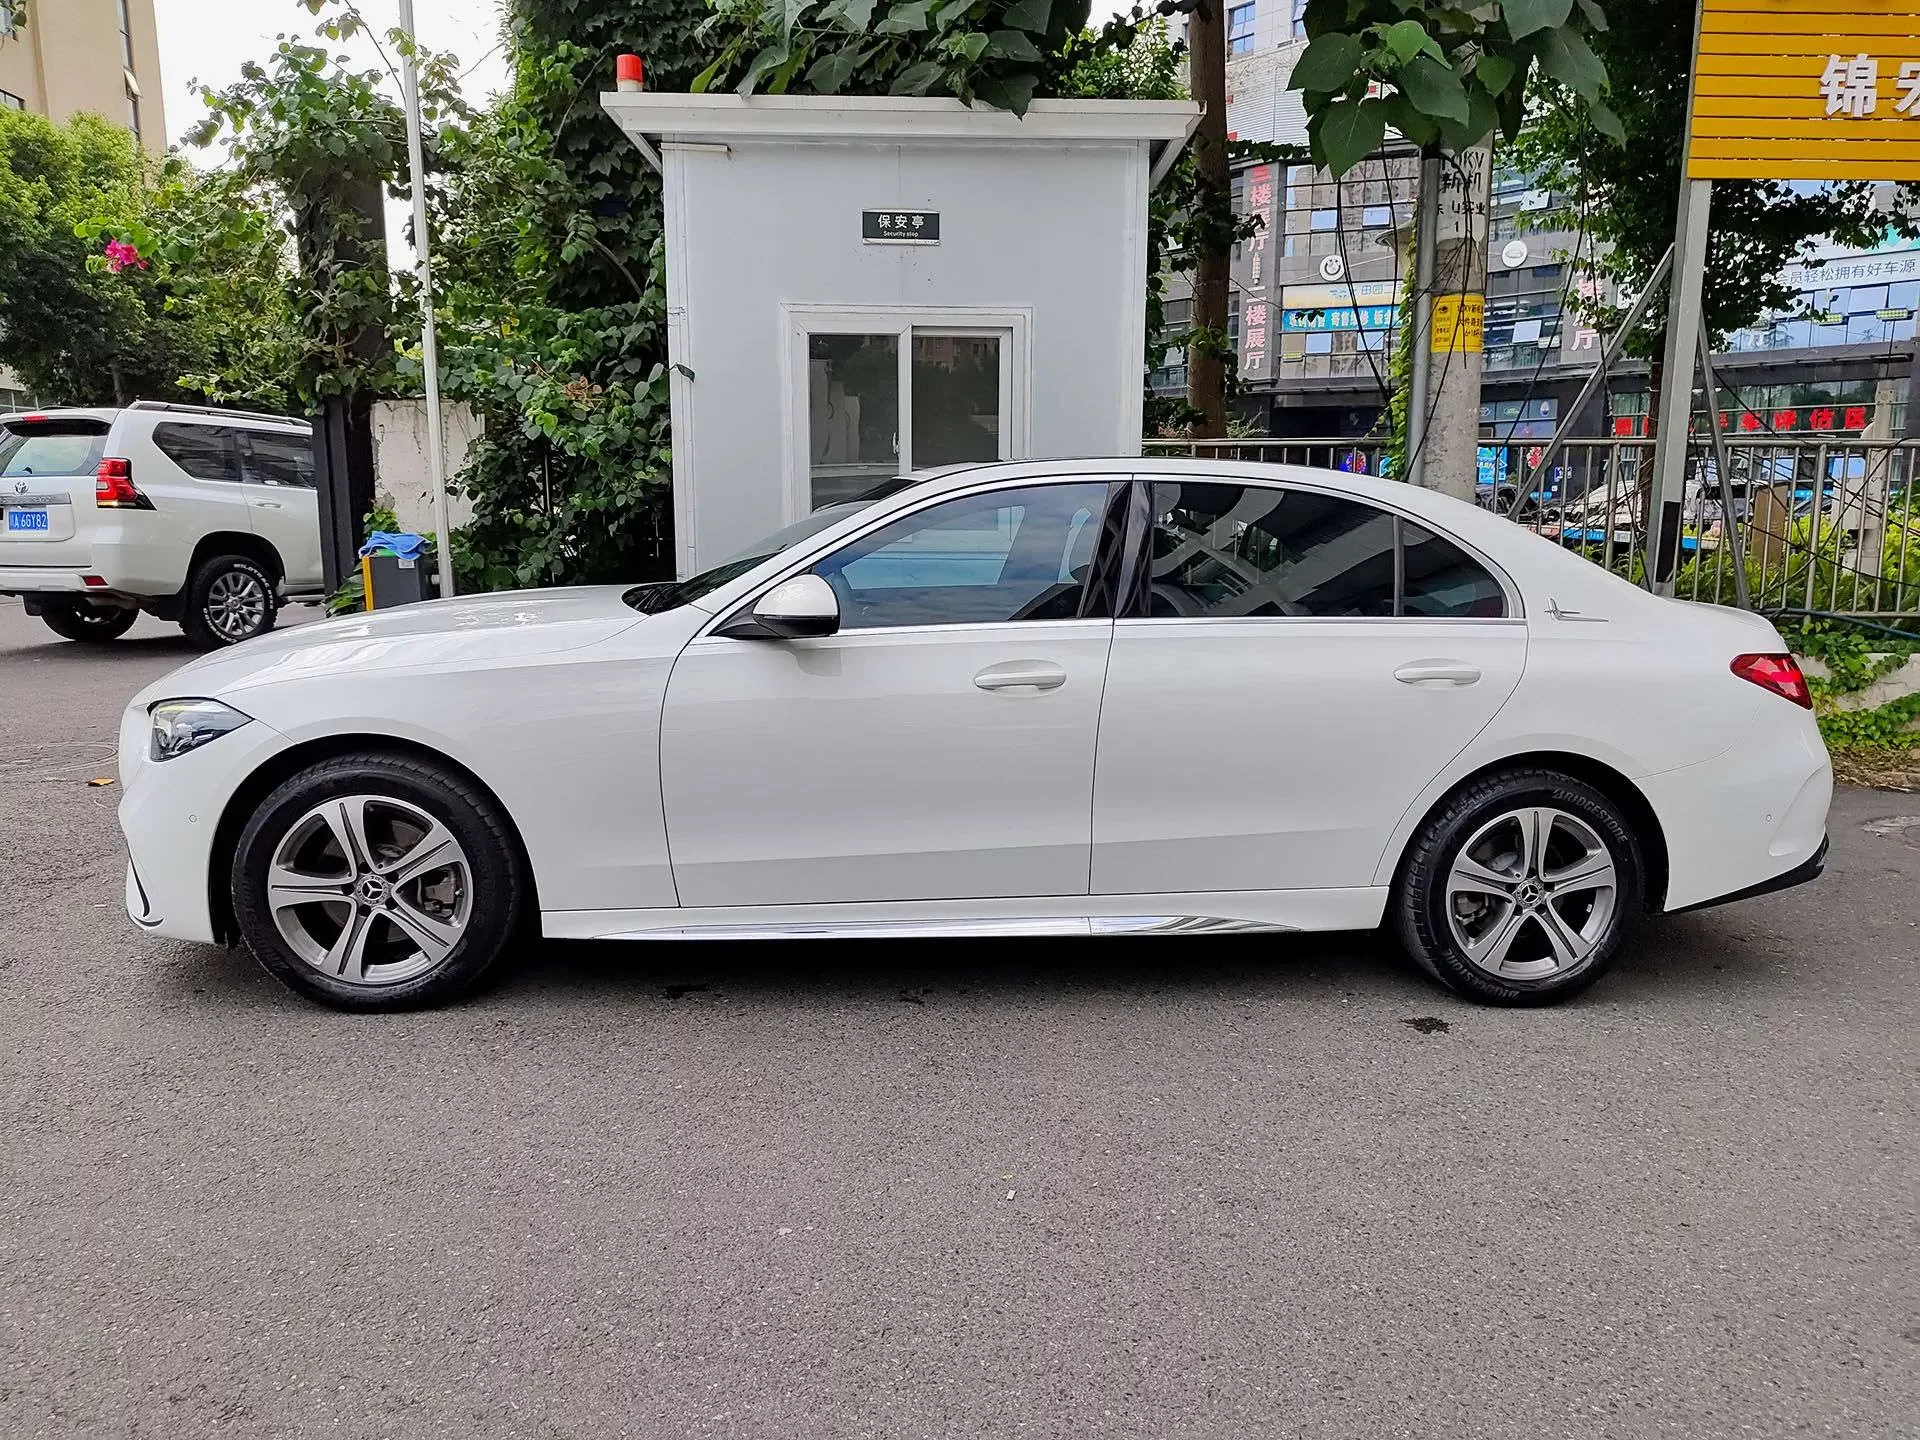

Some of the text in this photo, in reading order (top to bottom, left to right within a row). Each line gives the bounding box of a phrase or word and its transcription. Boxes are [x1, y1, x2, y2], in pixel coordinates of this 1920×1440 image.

[878, 214, 924, 229] 保安亭
[1244, 285, 1267, 370] 二楼展厅
[1552, 787, 1628, 843] BRIDGESTONE
